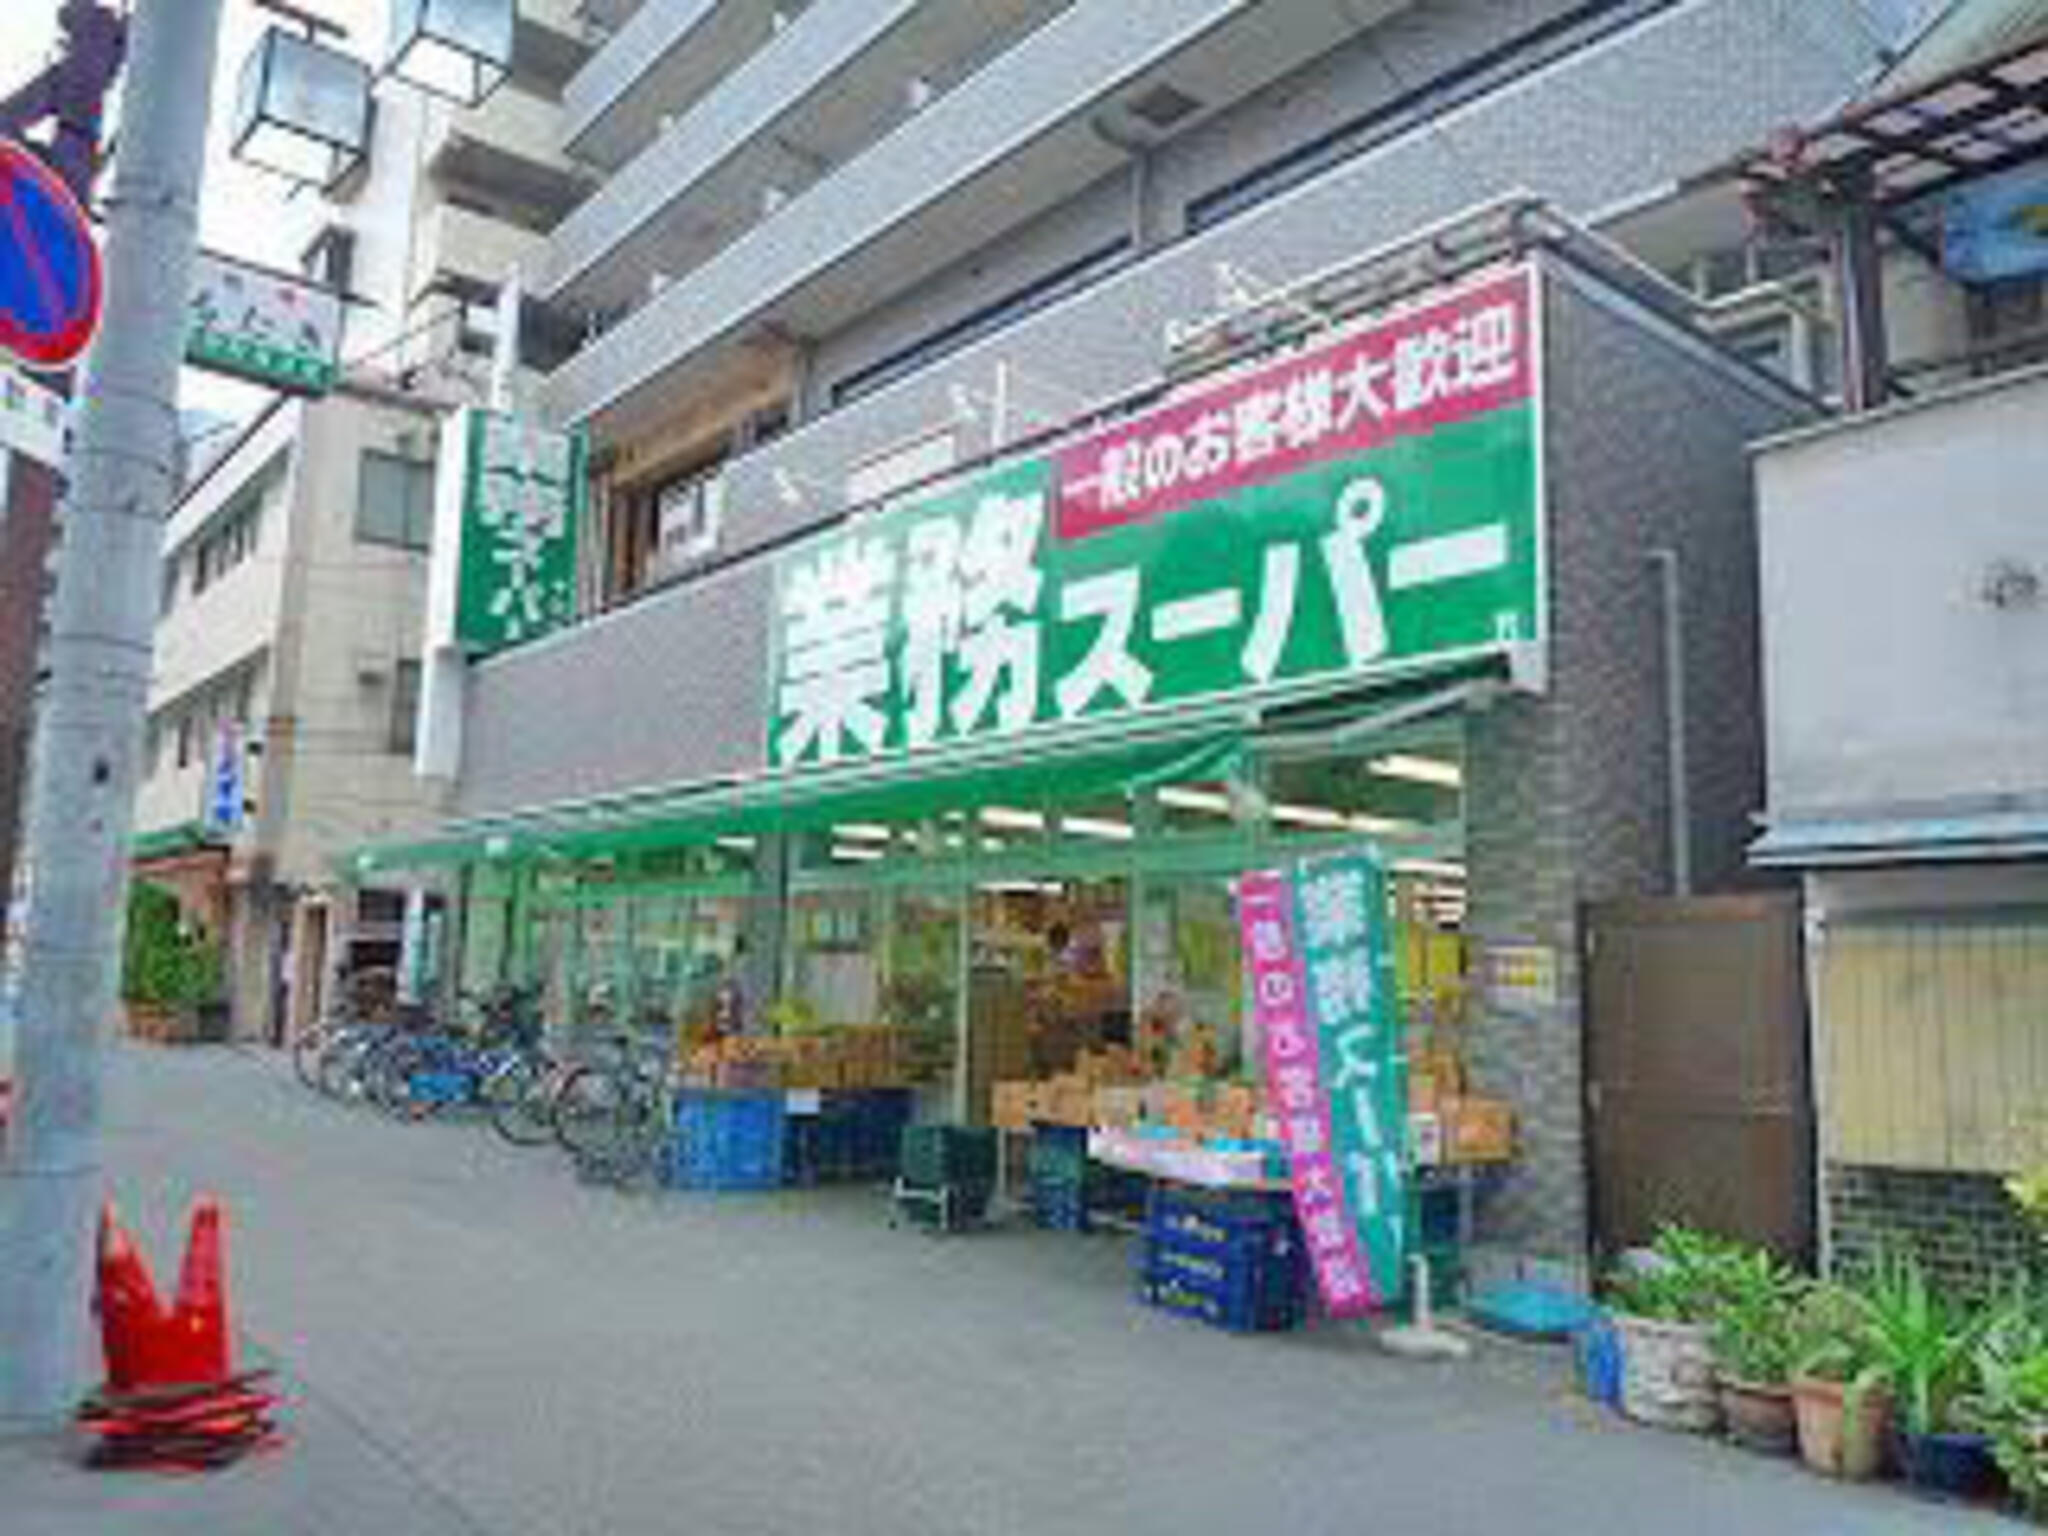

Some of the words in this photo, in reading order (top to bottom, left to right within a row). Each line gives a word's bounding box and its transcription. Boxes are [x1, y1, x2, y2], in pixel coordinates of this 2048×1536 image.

[1061, 302, 1519, 511] 一般のお客様大歓迎
[776, 476, 1508, 768] 業務スーパー
